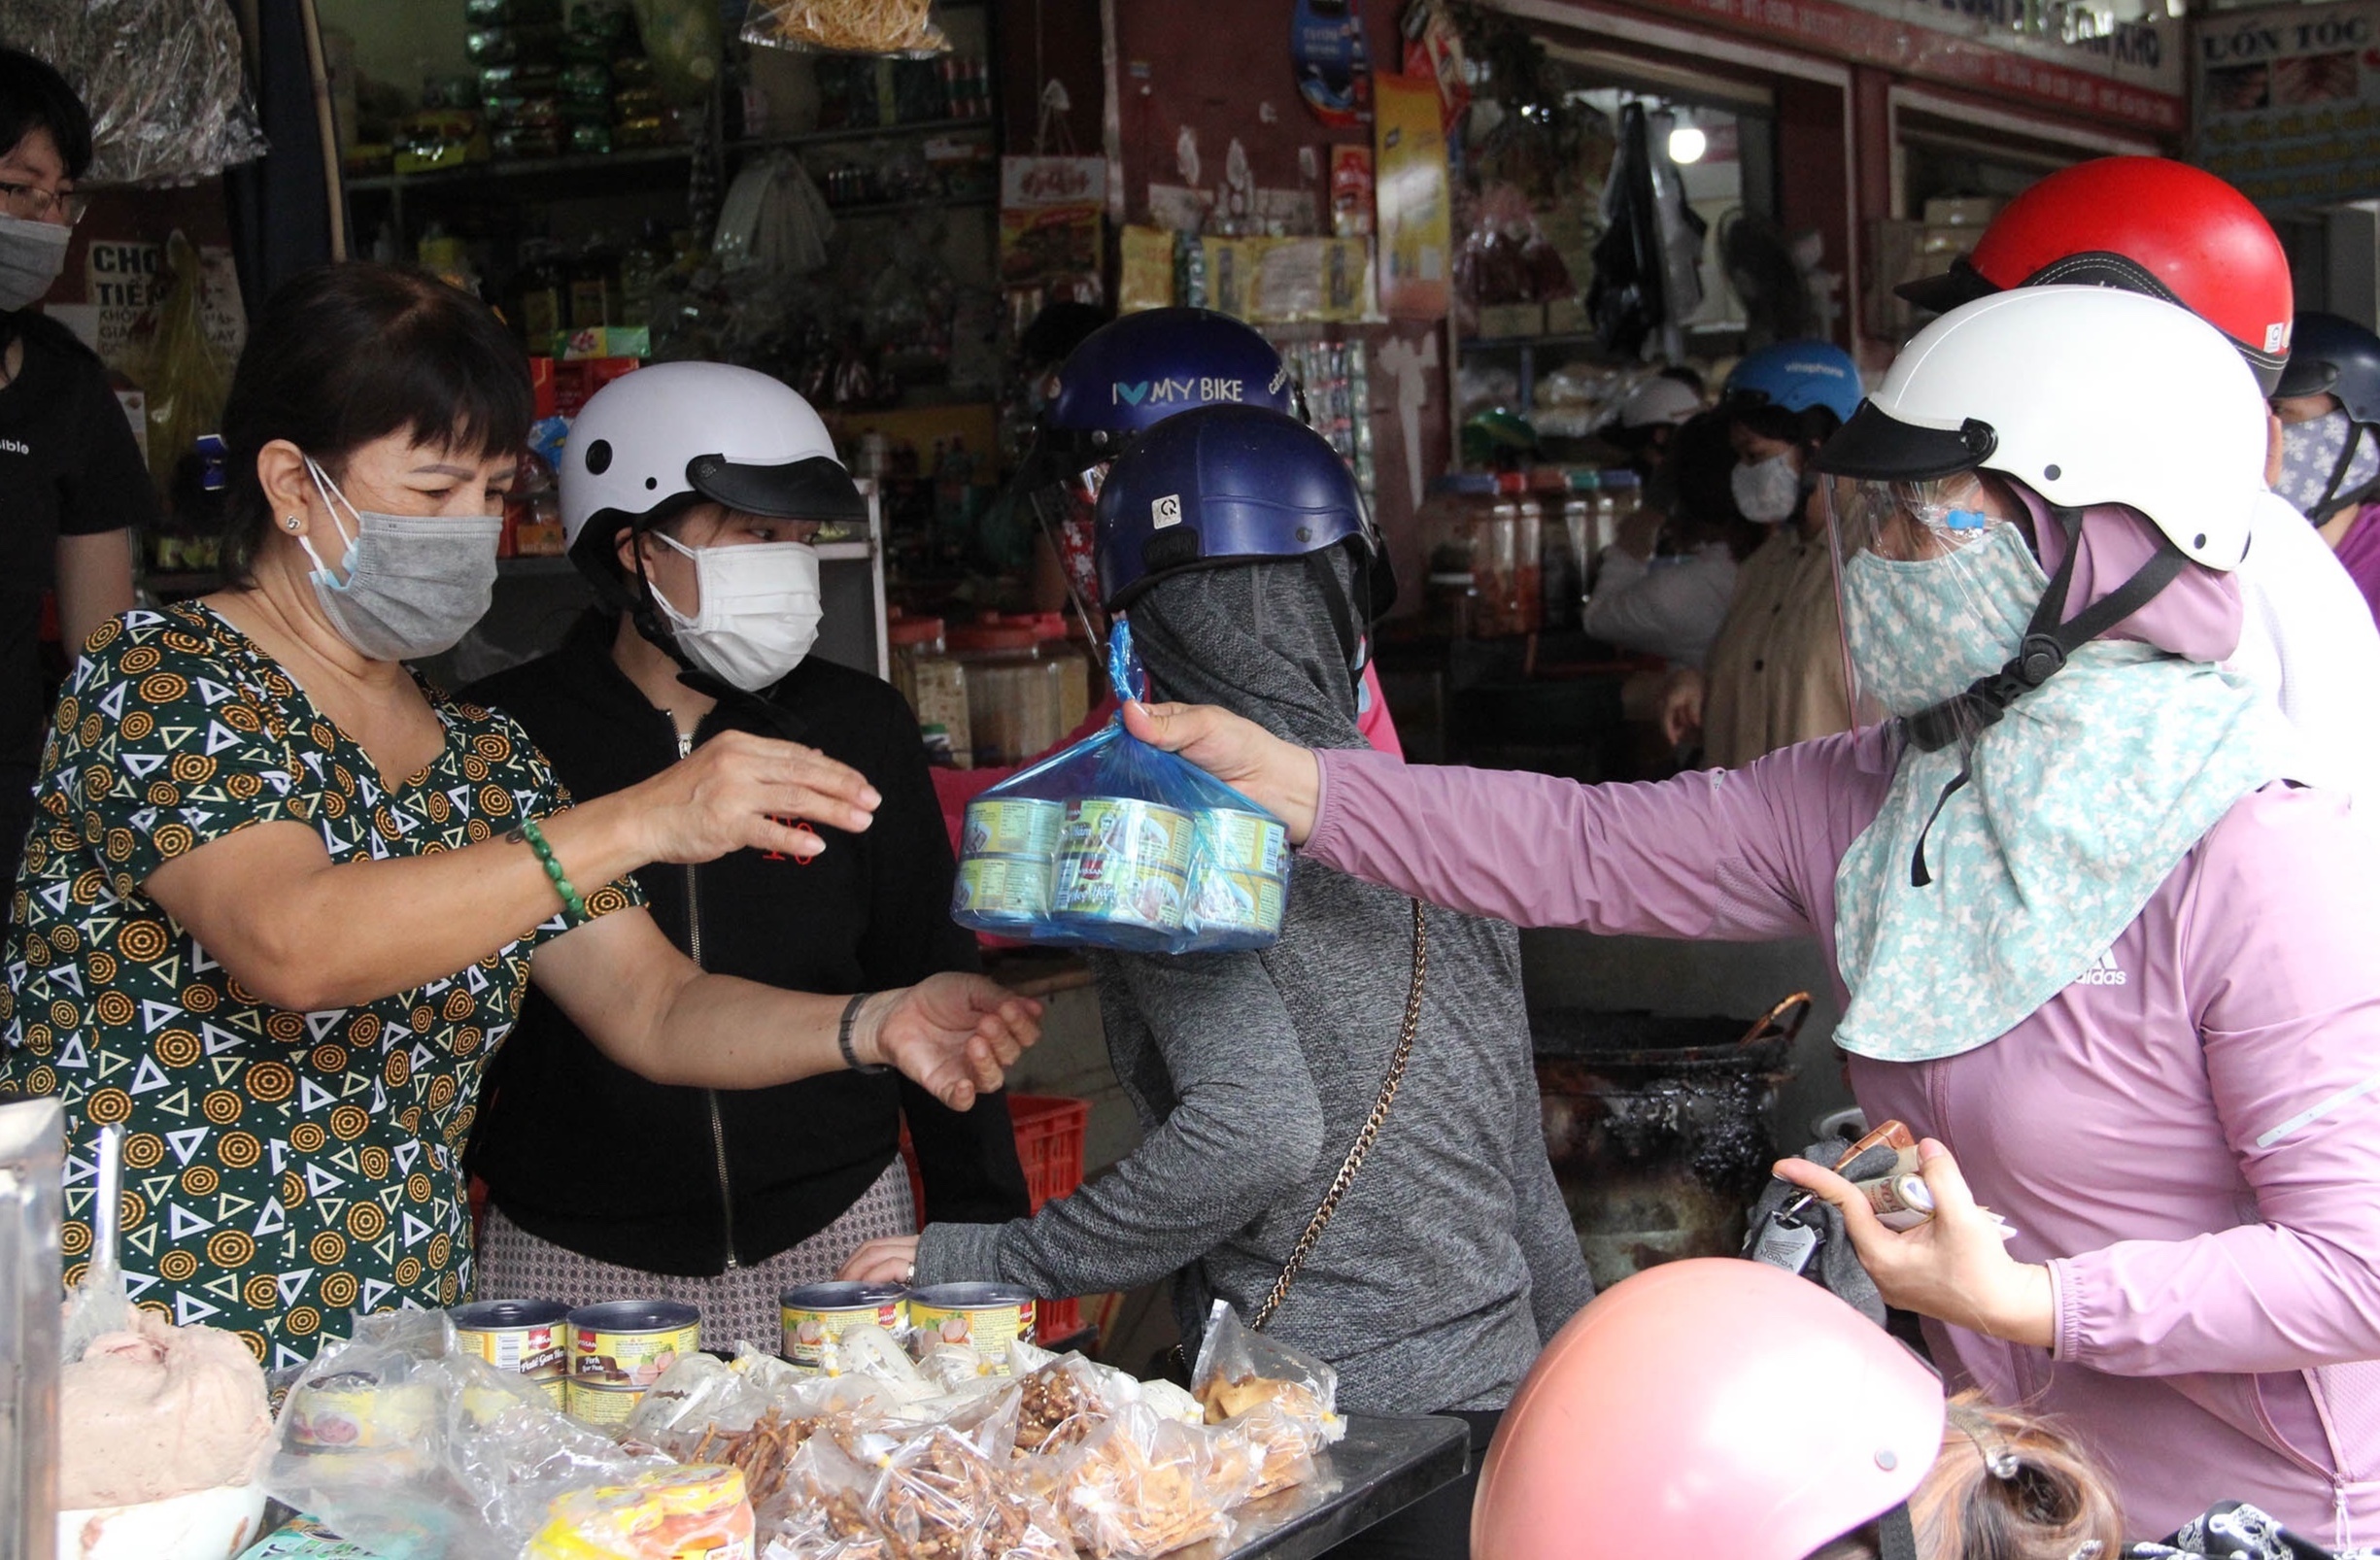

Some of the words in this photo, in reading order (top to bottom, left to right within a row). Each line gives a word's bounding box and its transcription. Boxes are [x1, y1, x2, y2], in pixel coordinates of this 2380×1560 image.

[1112, 382, 1118, 406] I
[1149, 377, 1196, 403] MY
[1200, 377, 1243, 403] BIKE
[0, 439, 30, 455] ible
[2074, 968, 2127, 985] idas
[1759, 1249, 1795, 1271] HONDA
